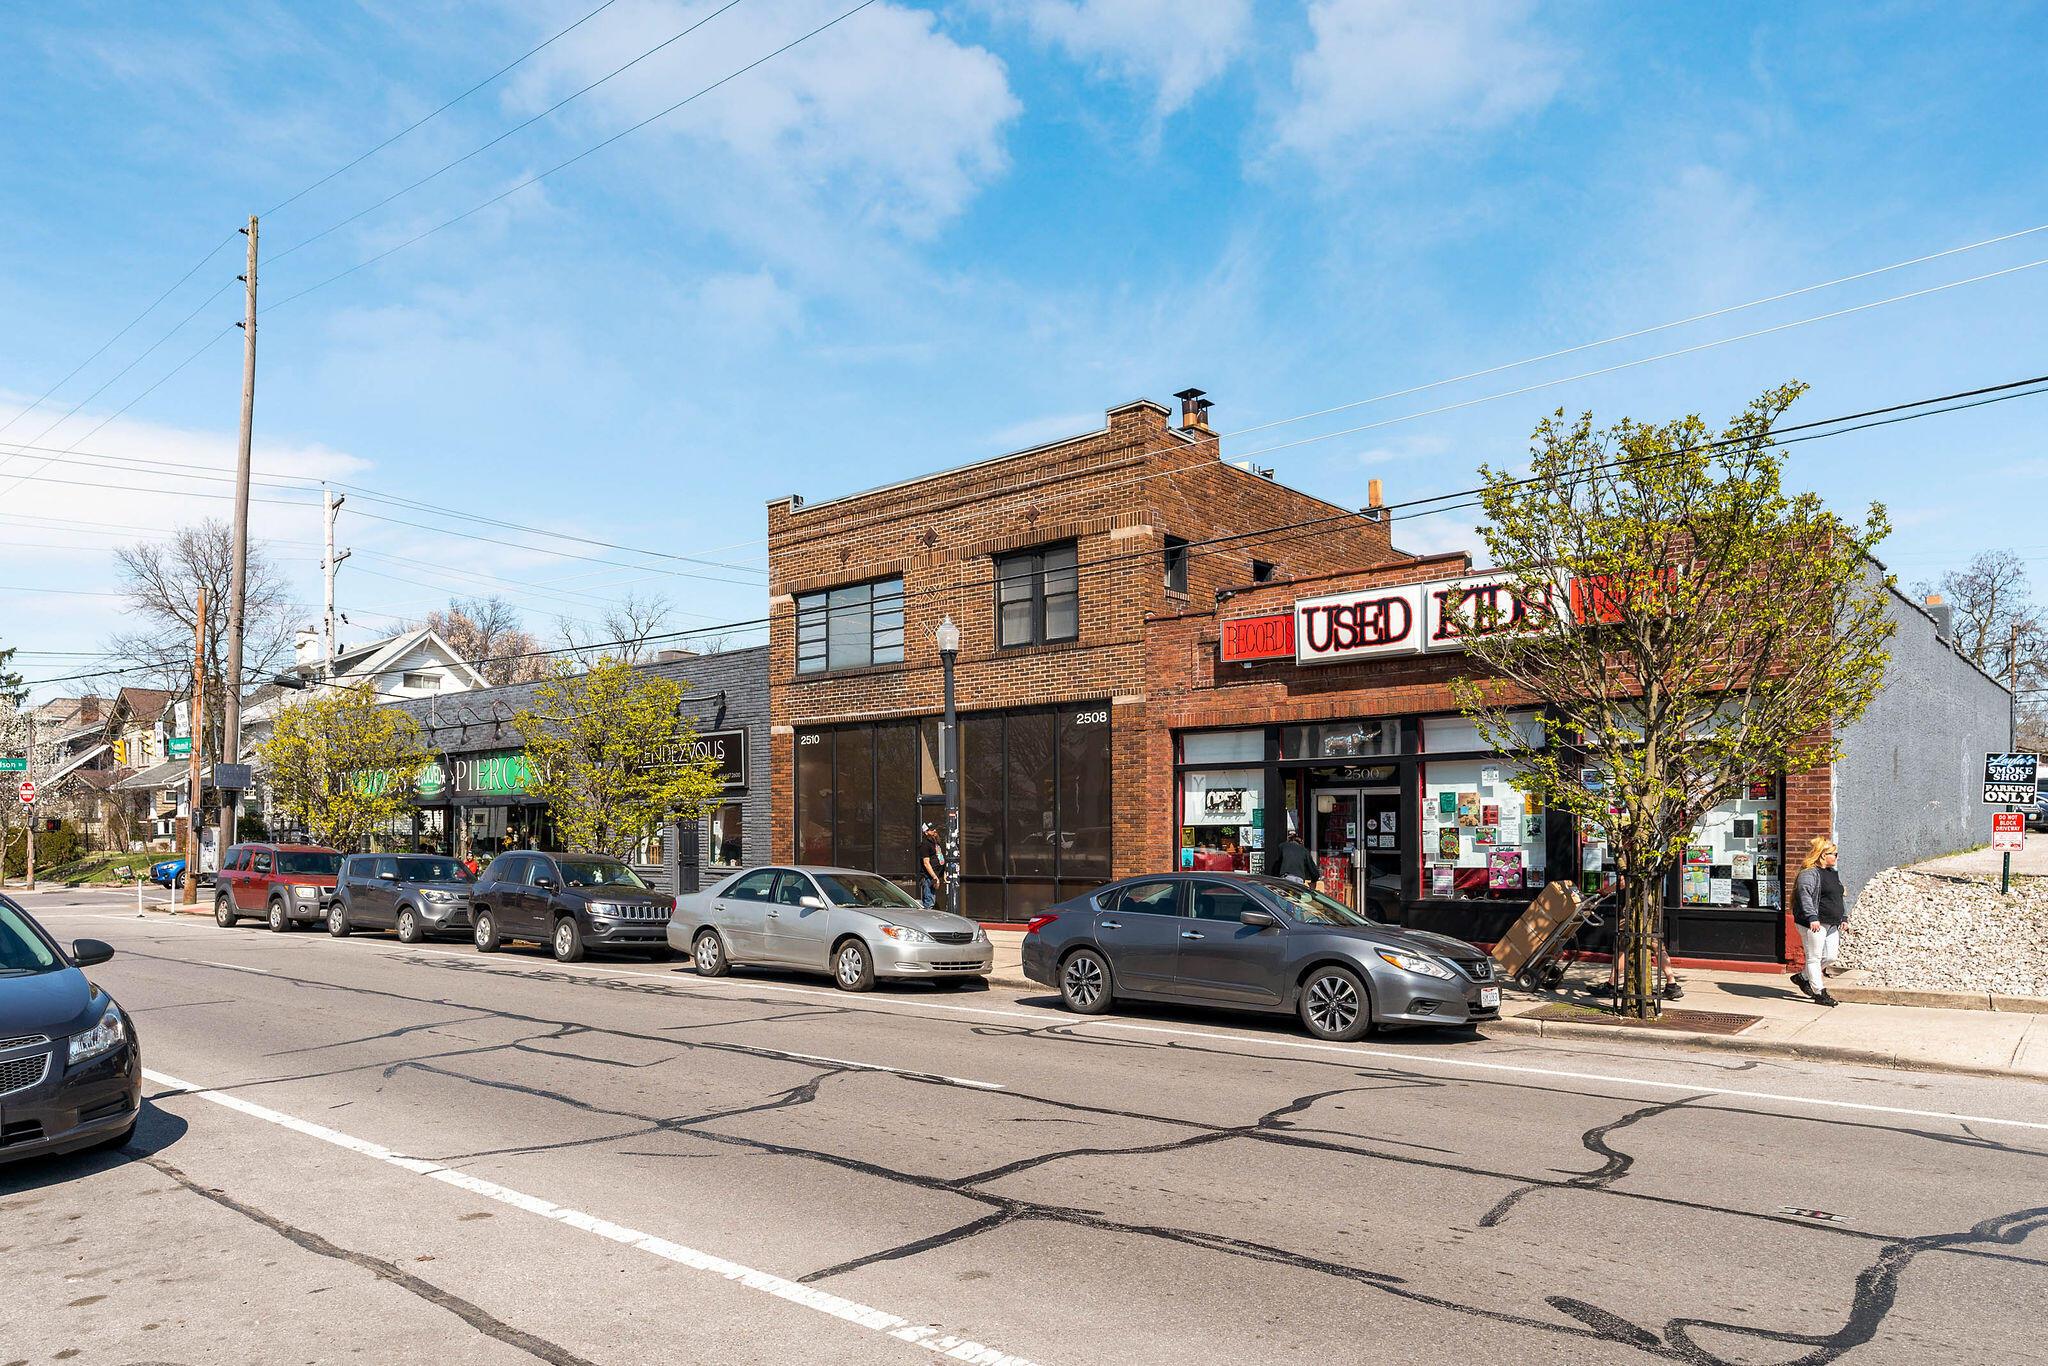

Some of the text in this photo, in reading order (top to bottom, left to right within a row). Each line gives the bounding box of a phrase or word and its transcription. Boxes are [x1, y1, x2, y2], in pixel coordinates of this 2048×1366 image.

[1432, 583, 1553, 641] KIDS
[1301, 596, 1413, 653] USED
[1226, 620, 1294, 656] RECORDS
[1077, 711, 1107, 724] 2508
[800, 734, 820, 745] 2510
[1988, 754, 2036, 768] Layla's
[1344, 768, 1380, 780] 2500
[1988, 767, 2034, 775] SMOKE
[1984, 791, 2034, 802] ONLY
